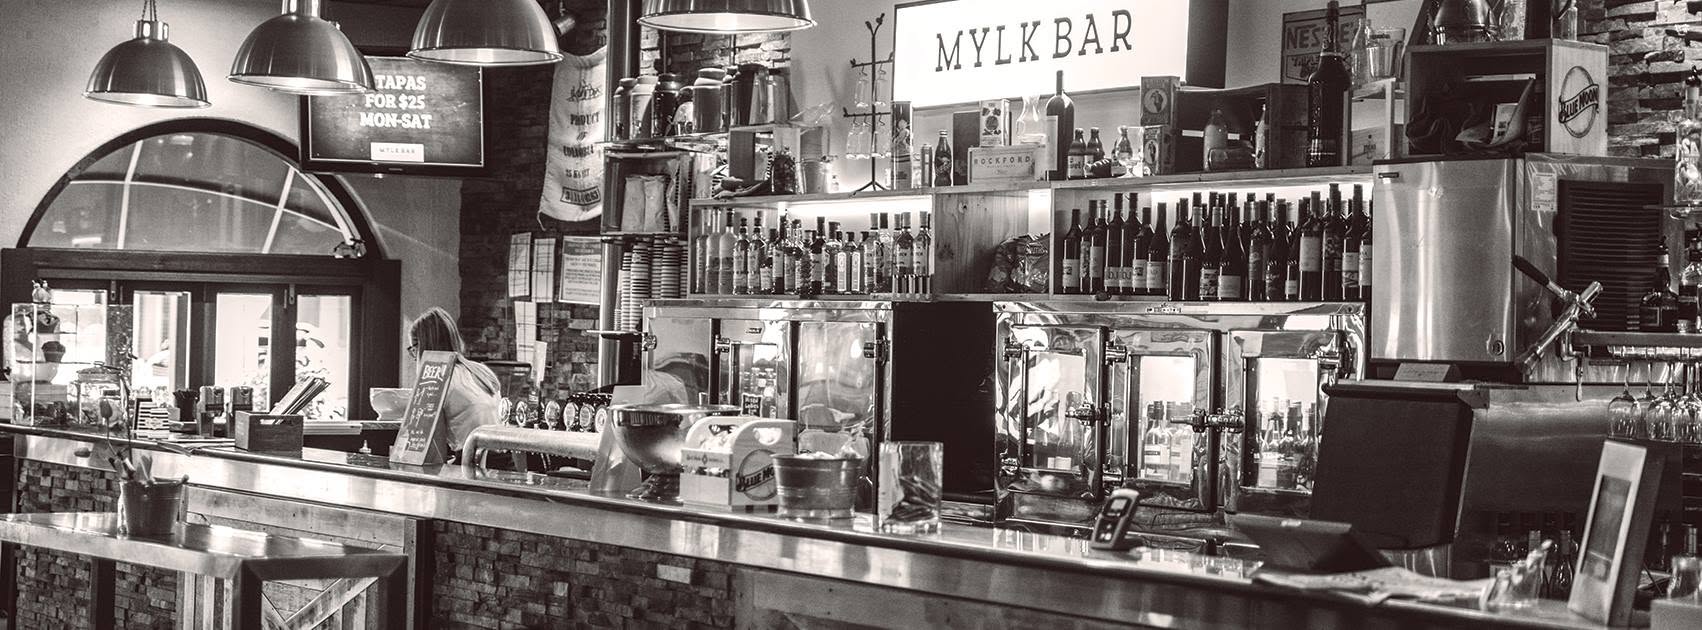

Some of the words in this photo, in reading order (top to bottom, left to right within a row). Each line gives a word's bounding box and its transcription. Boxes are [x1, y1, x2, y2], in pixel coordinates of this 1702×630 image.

[935, 20, 1041, 72] MYLK
[1052, 9, 1133, 58] BAR
[374, 74, 427, 91] TAPAS
[364, 93, 397, 109] FOR
[398, 93, 426, 110] $25
[1559, 98, 1578, 123] BLUE
[1578, 87, 1598, 111] MOON
[359, 112, 433, 129] MON-SAT
